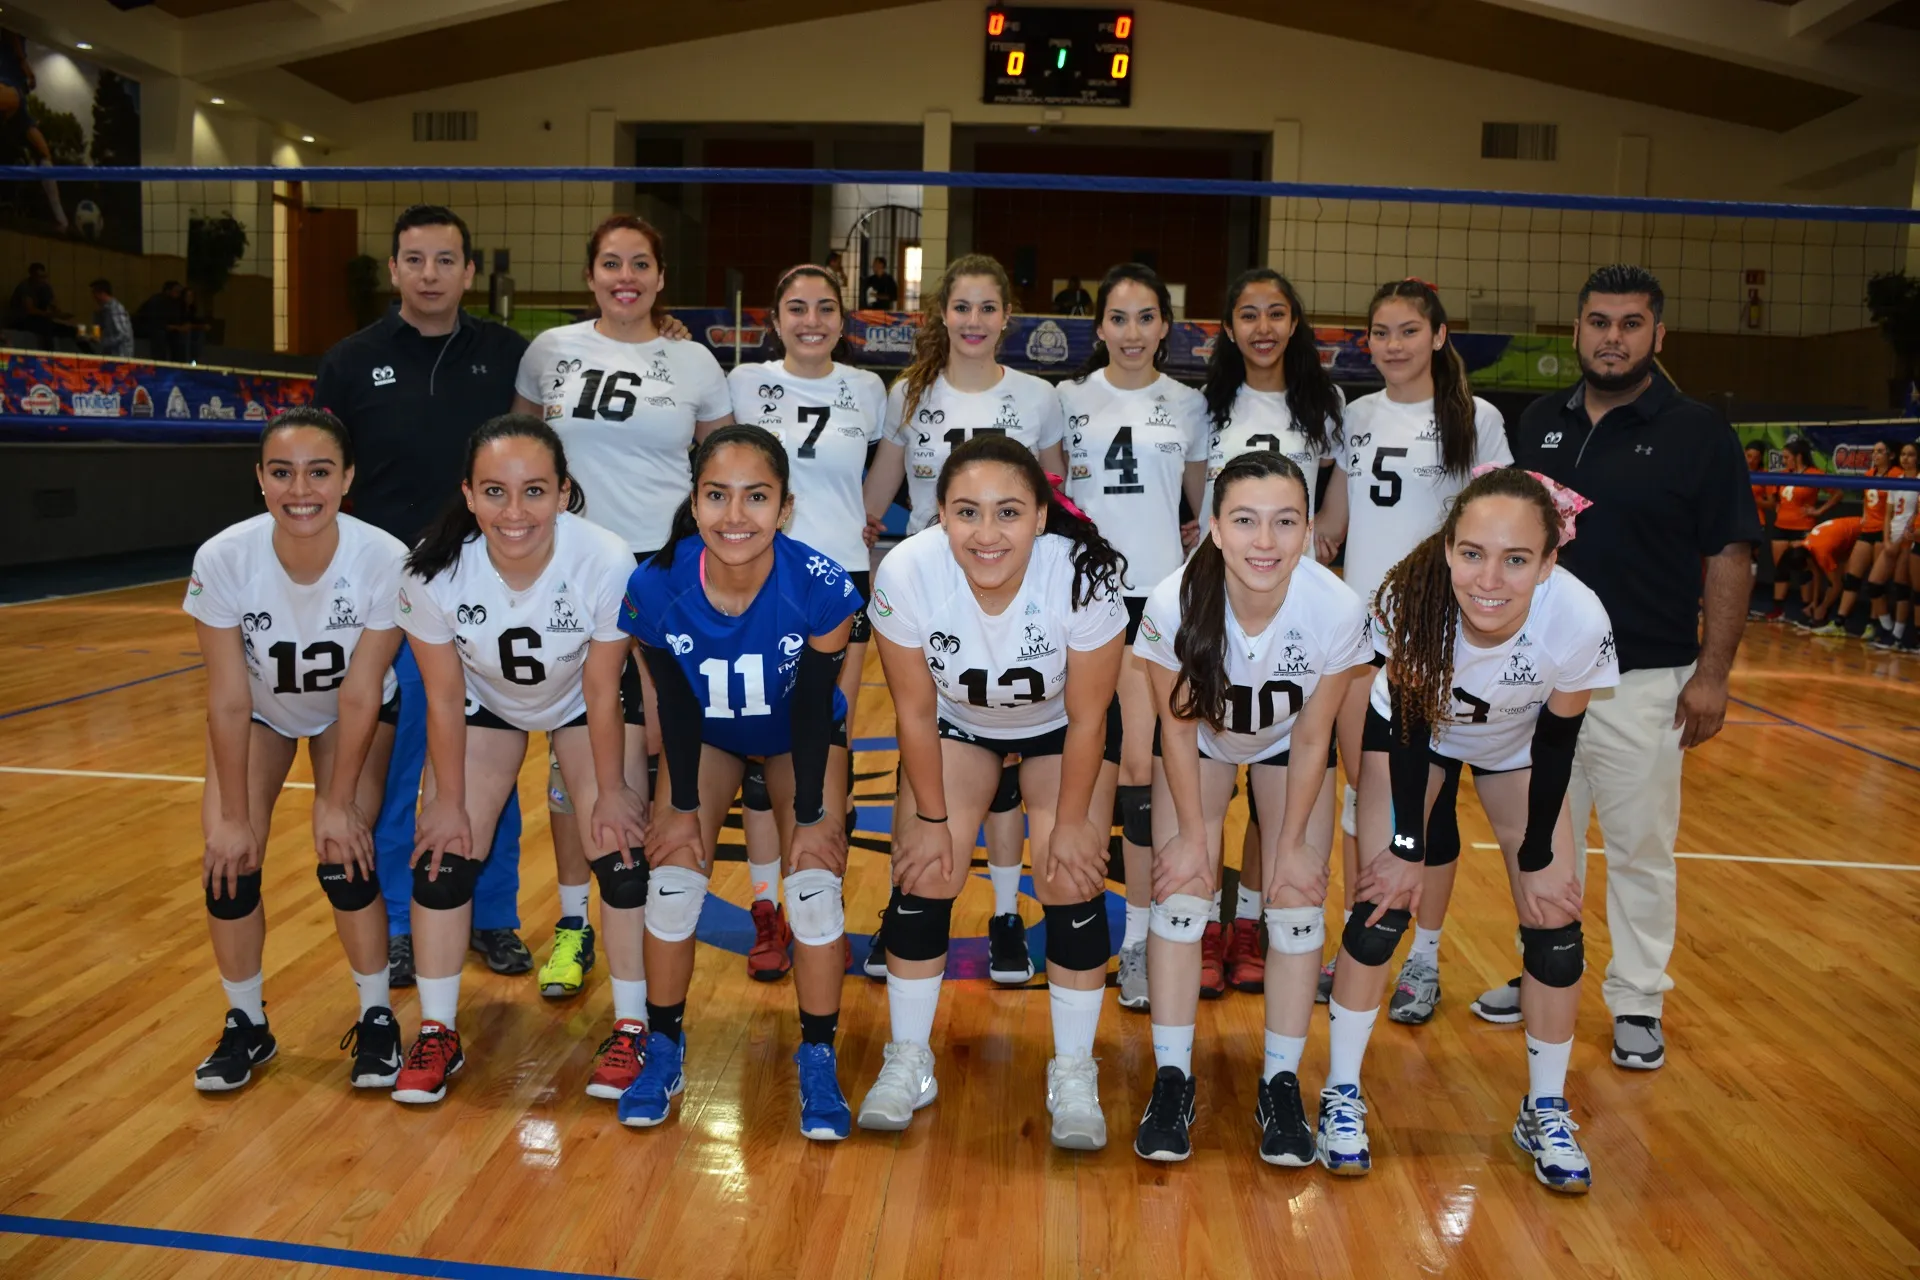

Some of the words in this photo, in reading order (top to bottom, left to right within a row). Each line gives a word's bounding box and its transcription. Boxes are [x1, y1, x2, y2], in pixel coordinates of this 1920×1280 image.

[988, 14, 1004, 35] 0
[1115, 17, 1131, 38] 0
[1007, 51, 1025, 76] 0
[1057, 49, 1067, 69] 1
[1111, 54, 1129, 78] 0
[572, 369, 642, 422] 16
[832, 400, 856, 409] LMV
[798, 406, 830, 459] 7
[996, 417, 1020, 426] LMV
[1147, 417, 1172, 427] LMV
[1104, 426, 1138, 484] 4
[1370, 447, 1408, 507] 5
[824, 564, 843, 586] CTU
[329, 616, 358, 626] LMV
[550, 618, 579, 628] LMV
[498, 626, 546, 685] 6
[1020, 642, 1050, 657] LMV
[269, 641, 346, 694] 12
[1278, 662, 1309, 672] LMV
[1504, 672, 1537, 682] LMV
[699, 653, 771, 718] 11
[959, 666, 1046, 709] 13
[1225, 680, 1303, 735] 10
